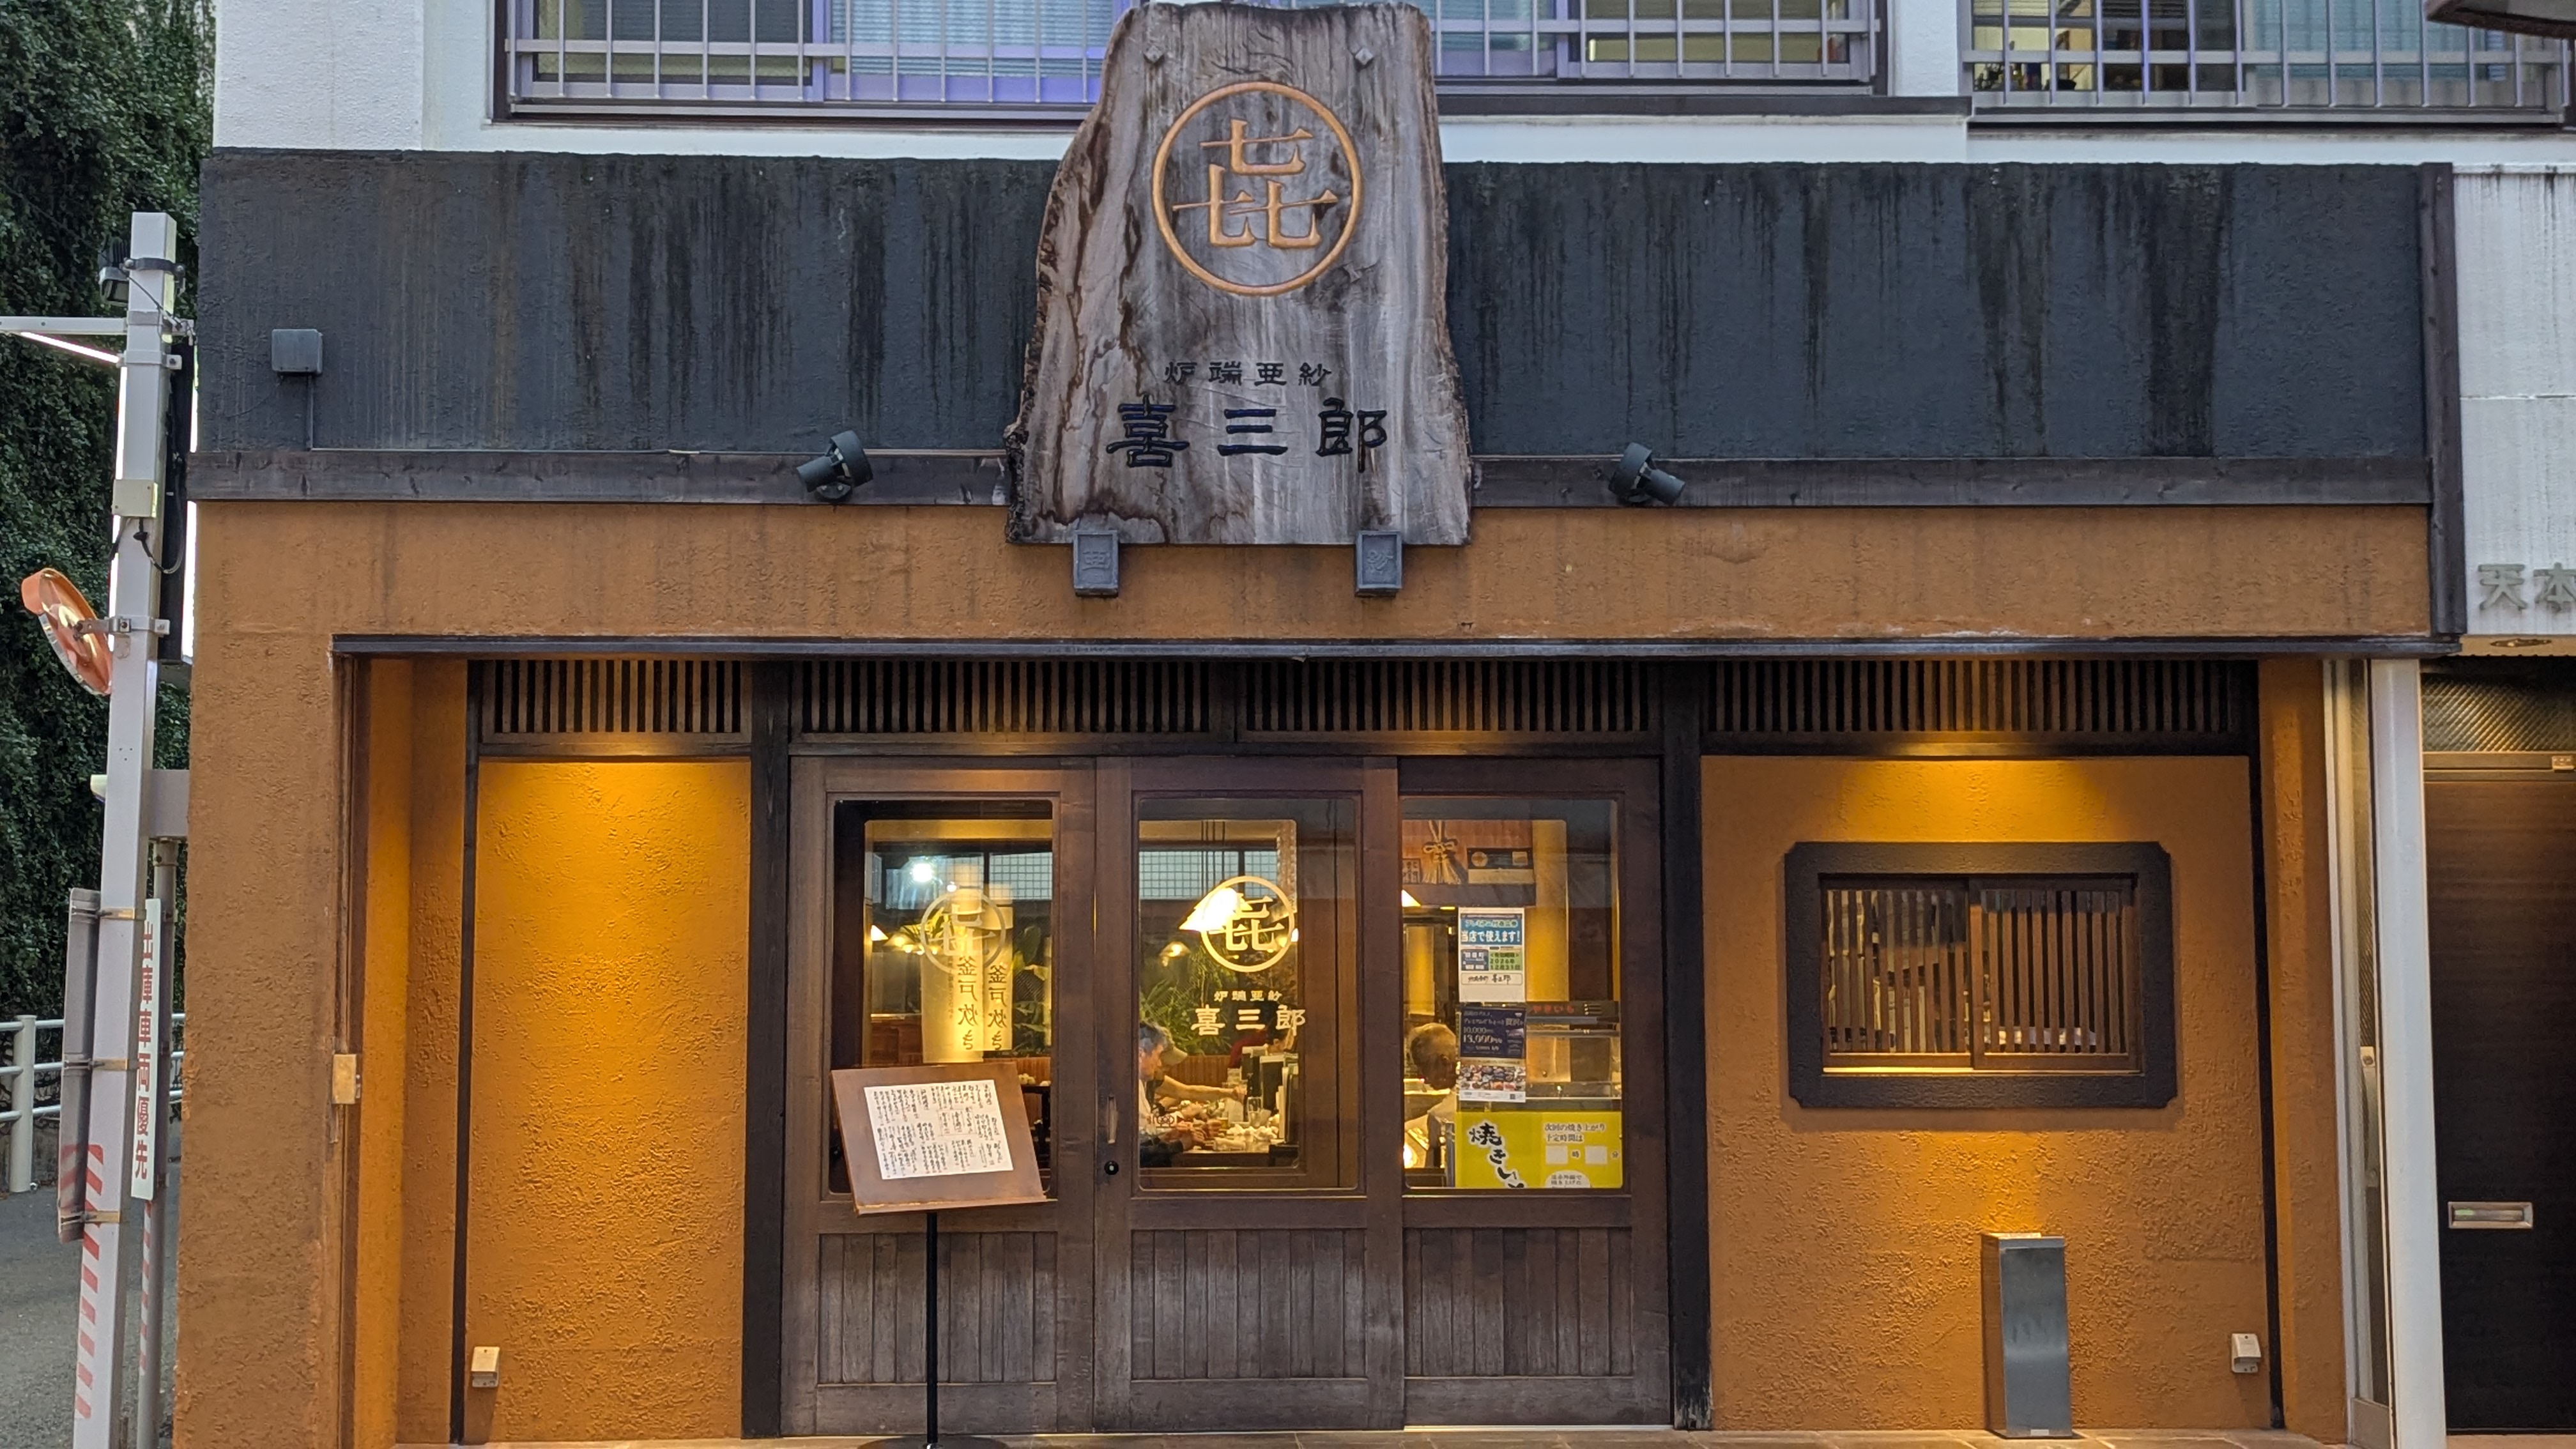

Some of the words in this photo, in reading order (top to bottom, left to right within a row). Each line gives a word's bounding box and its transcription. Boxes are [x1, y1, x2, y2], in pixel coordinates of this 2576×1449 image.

[1164, 361, 1332, 386] 炉端亜紗
[1106, 394, 1388, 473] 喜三郎
[1190, 1004, 1306, 1036] 喜三郎
[135, 920, 154, 1179] 出庫車両優先
